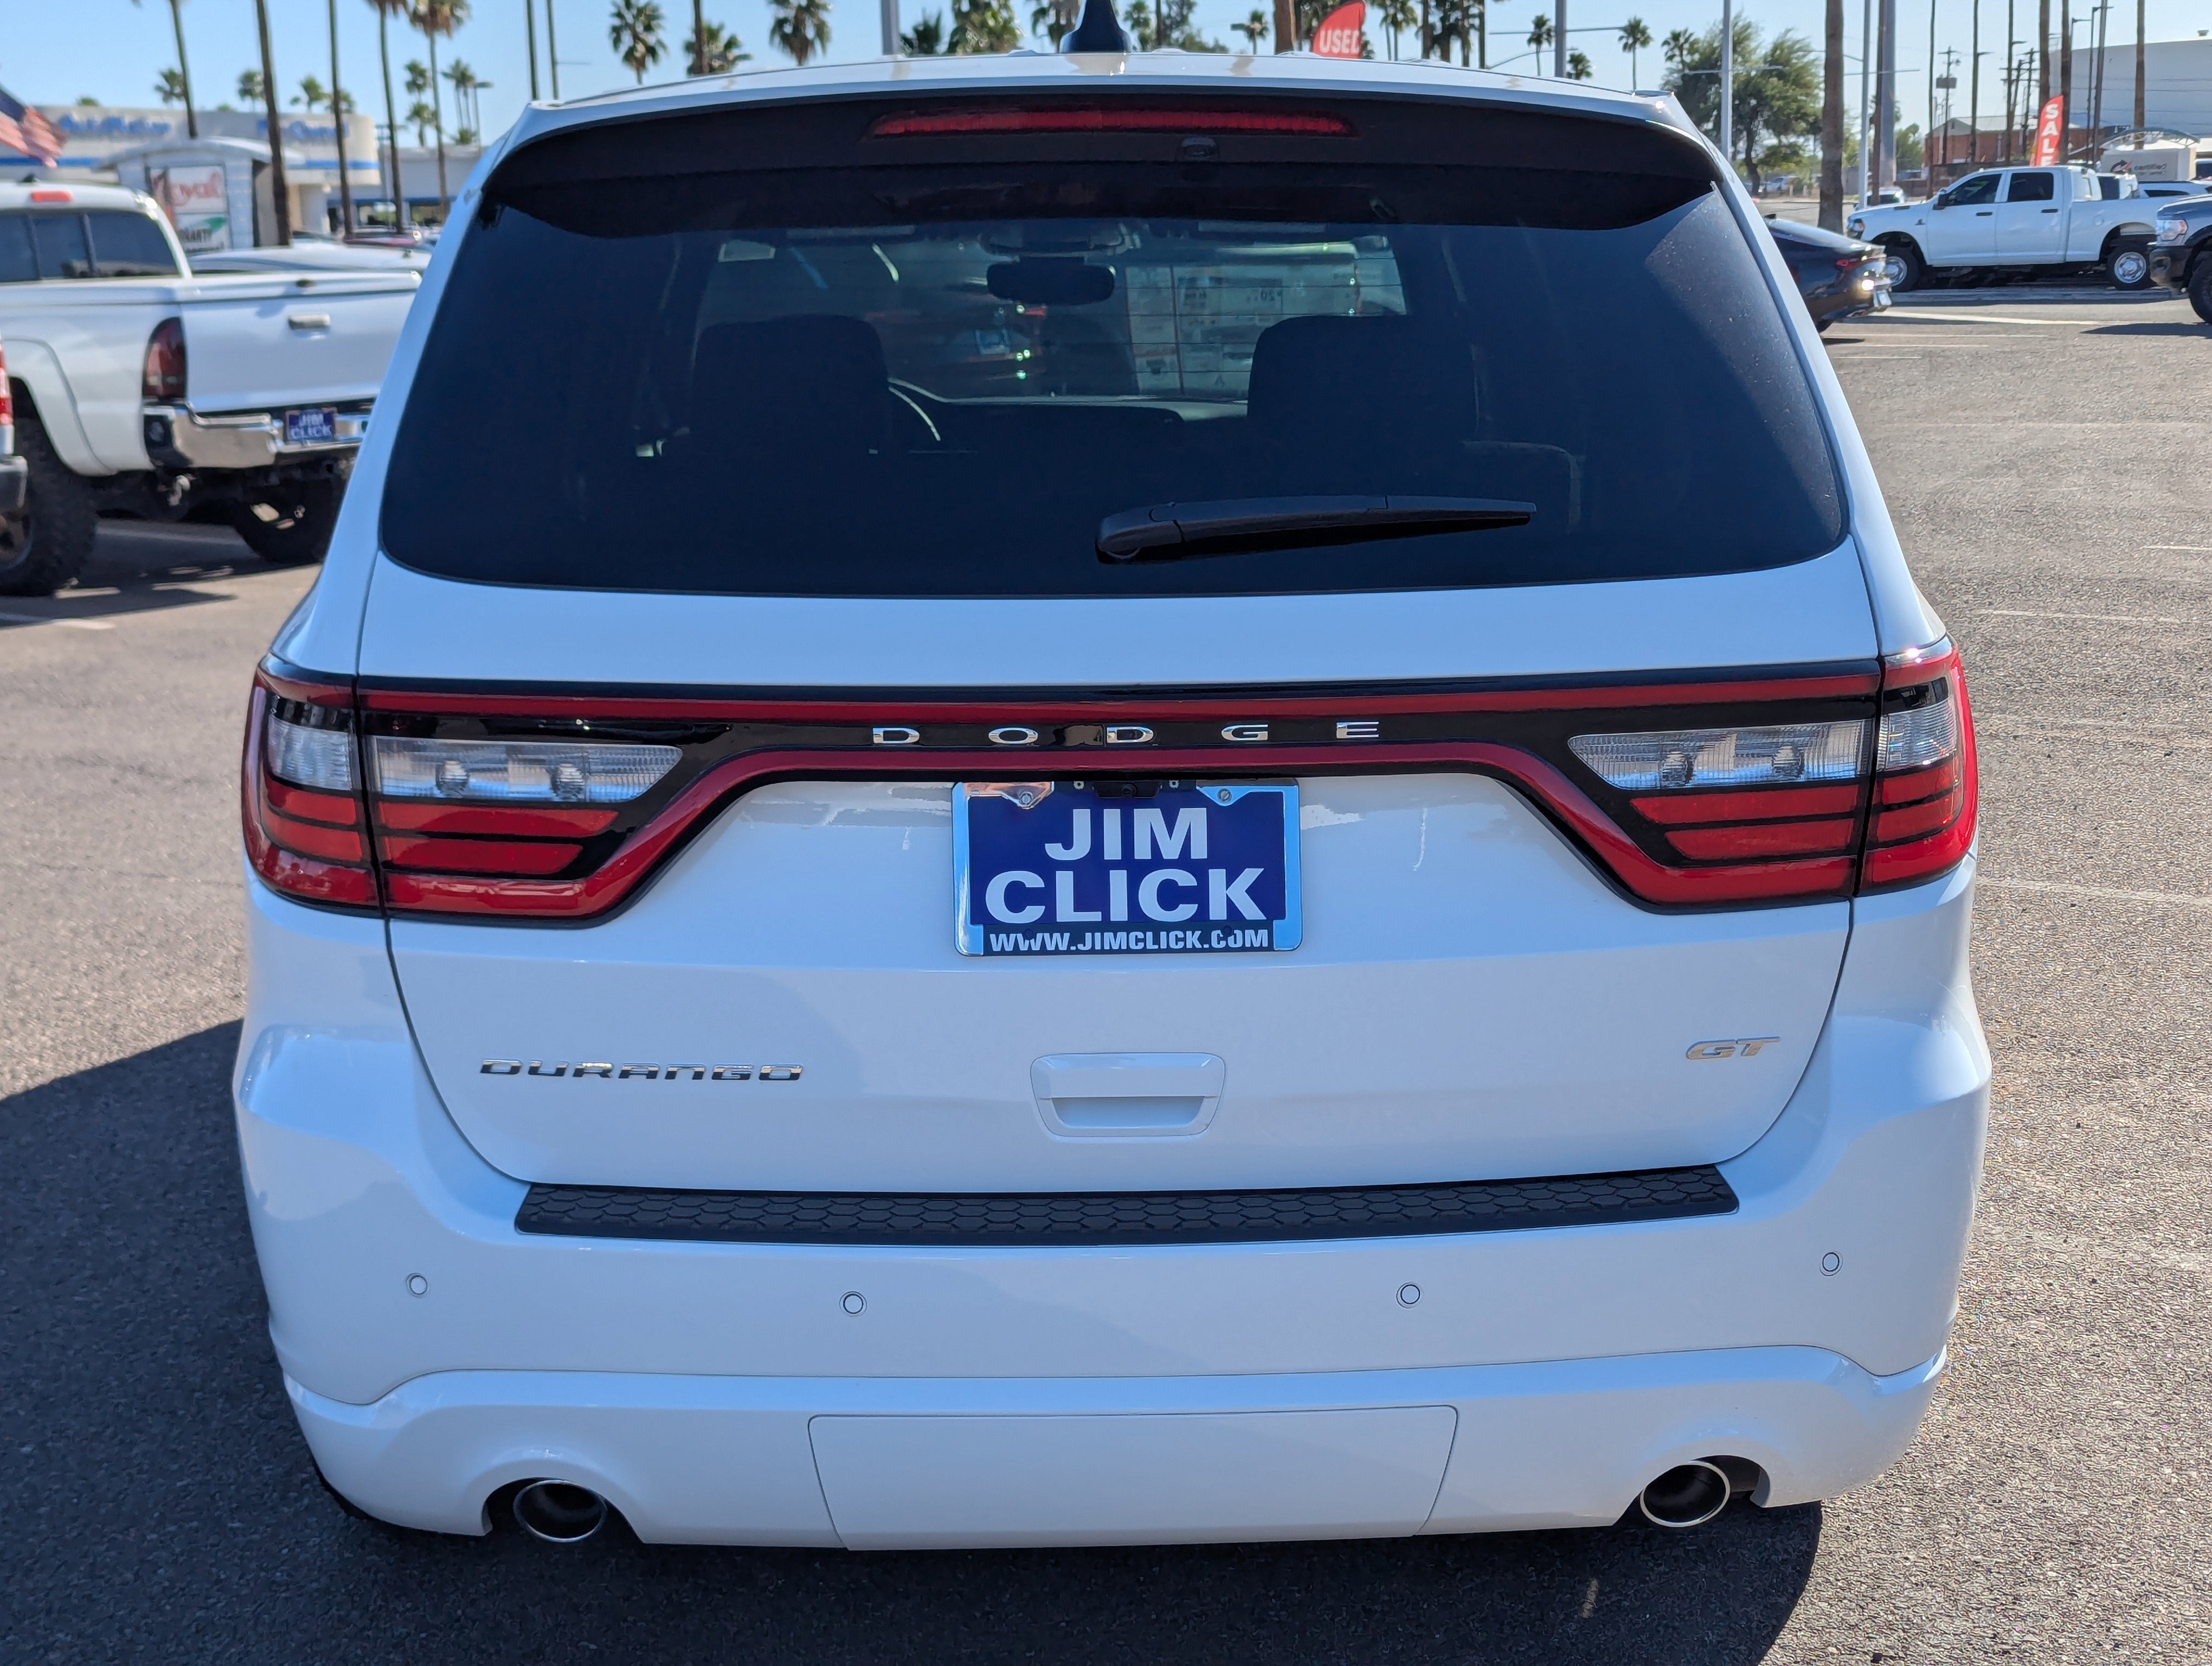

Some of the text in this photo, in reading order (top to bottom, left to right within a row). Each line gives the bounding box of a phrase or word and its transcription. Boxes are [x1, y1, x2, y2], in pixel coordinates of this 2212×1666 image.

[2041, 104, 2059, 166] SALE
[299, 414, 324, 426] JIM
[290, 425, 331, 439] CLICK
[873, 721, 1379, 744] DODGE
[1045, 808, 1207, 860] JIM
[985, 868, 1267, 923] CLICK
[989, 930, 1269, 951] WWW.JIMCLICK.COM
[1686, 1036, 1780, 1060] GT
[480, 1059, 804, 1081] DURANGO
